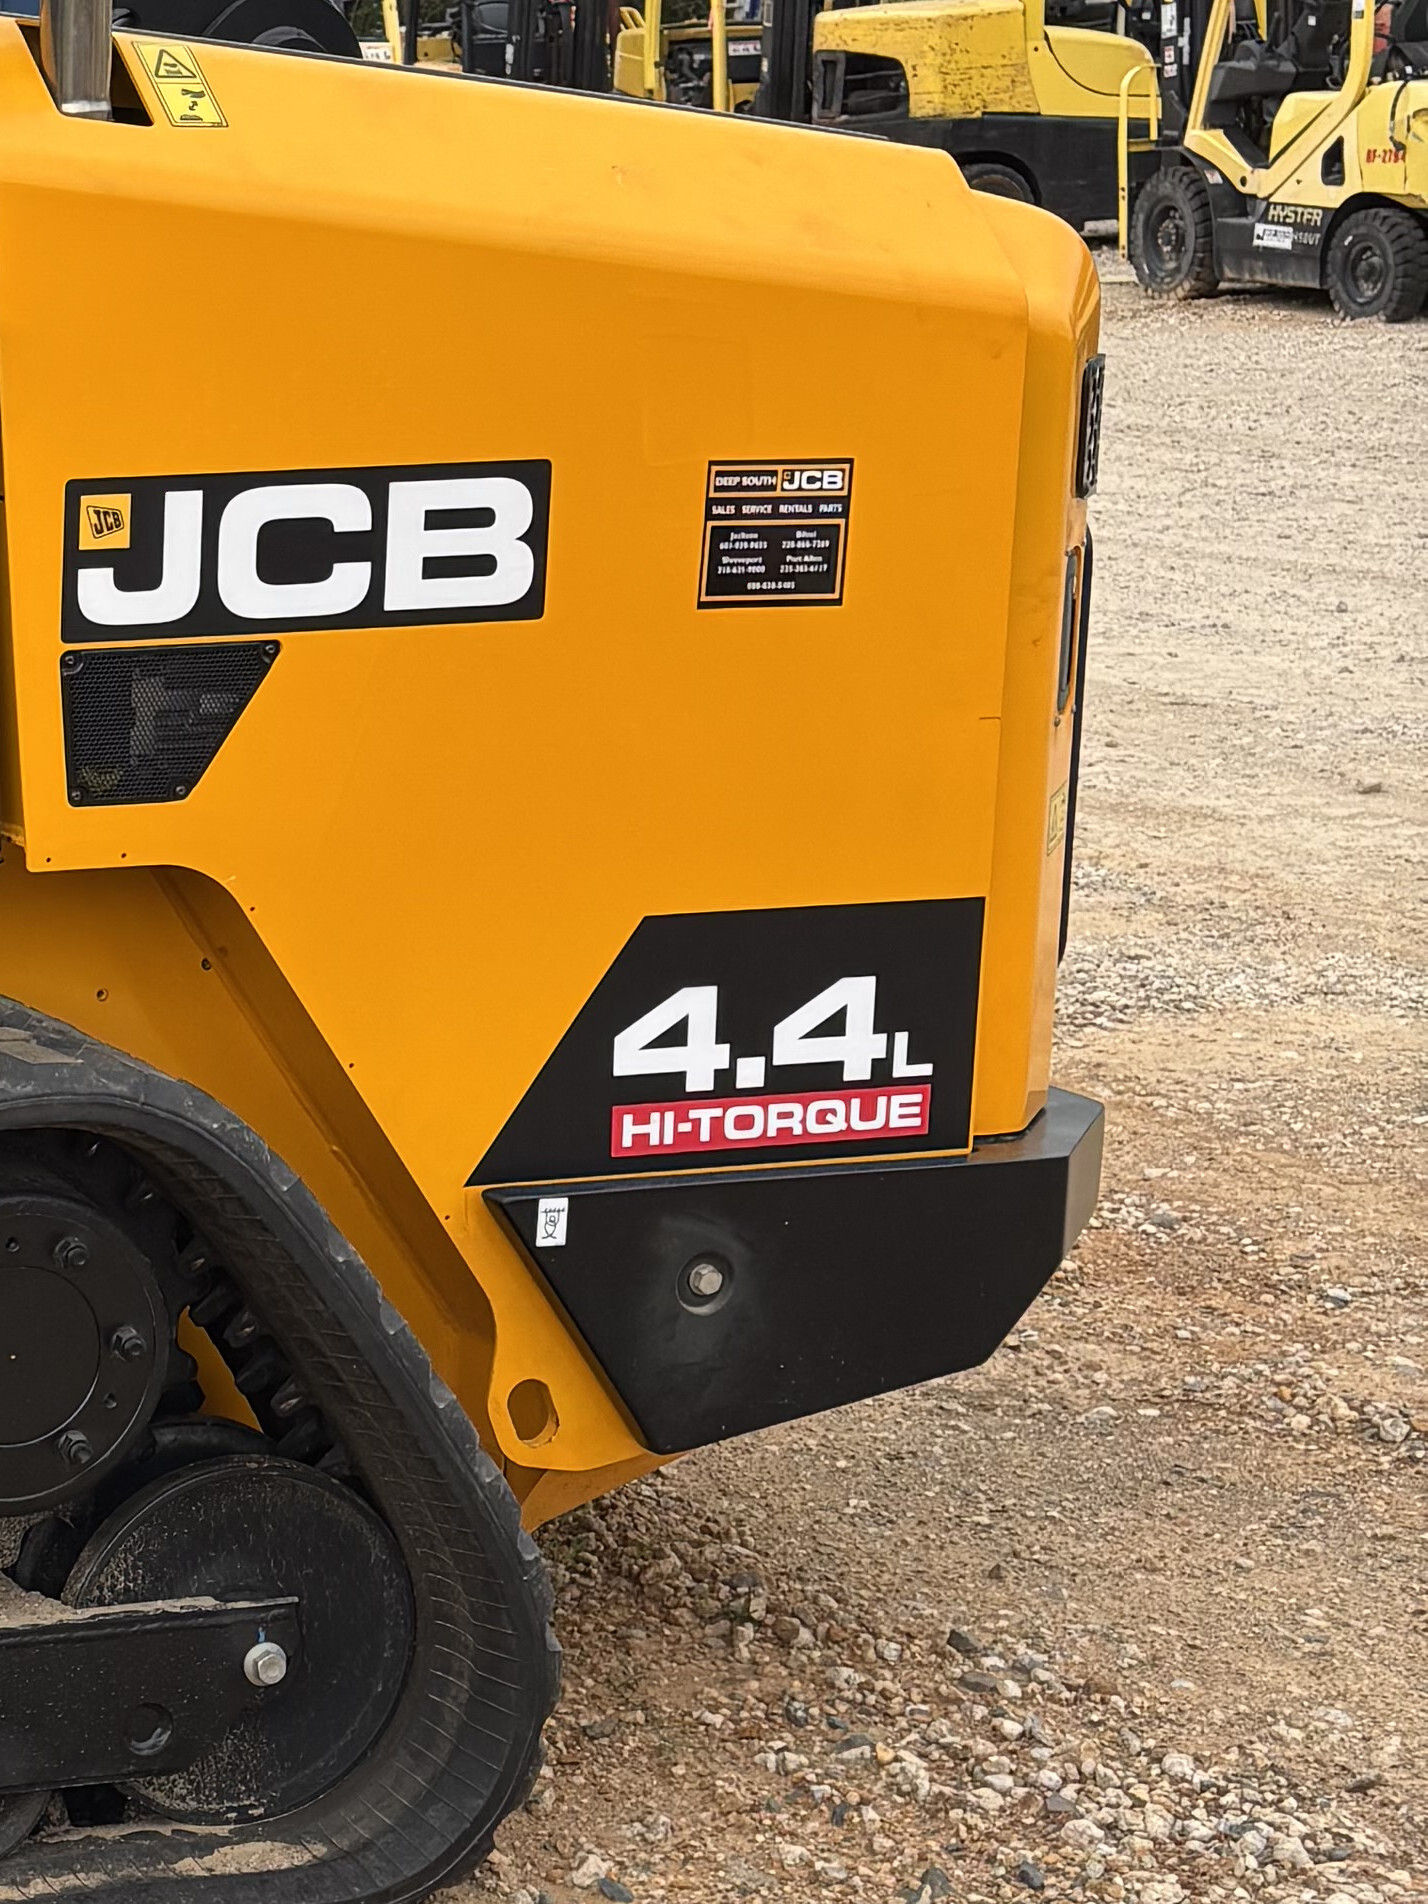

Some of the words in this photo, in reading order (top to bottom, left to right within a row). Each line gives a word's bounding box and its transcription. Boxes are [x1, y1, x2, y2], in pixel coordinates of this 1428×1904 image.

[715, 476, 741, 487] DEEP
[742, 475, 777, 487] SOUTH
[782, 470, 844, 490] JCB
[93, 509, 122, 535] JCB
[711, 505, 736, 515] SALES
[742, 504, 772, 514] SERVICE
[779, 503, 813, 514] RENTALS
[819, 503, 843, 513] PARTS
[77, 477, 535, 626] JCB
[622, 1094, 923, 1148] HI-TORQUE
